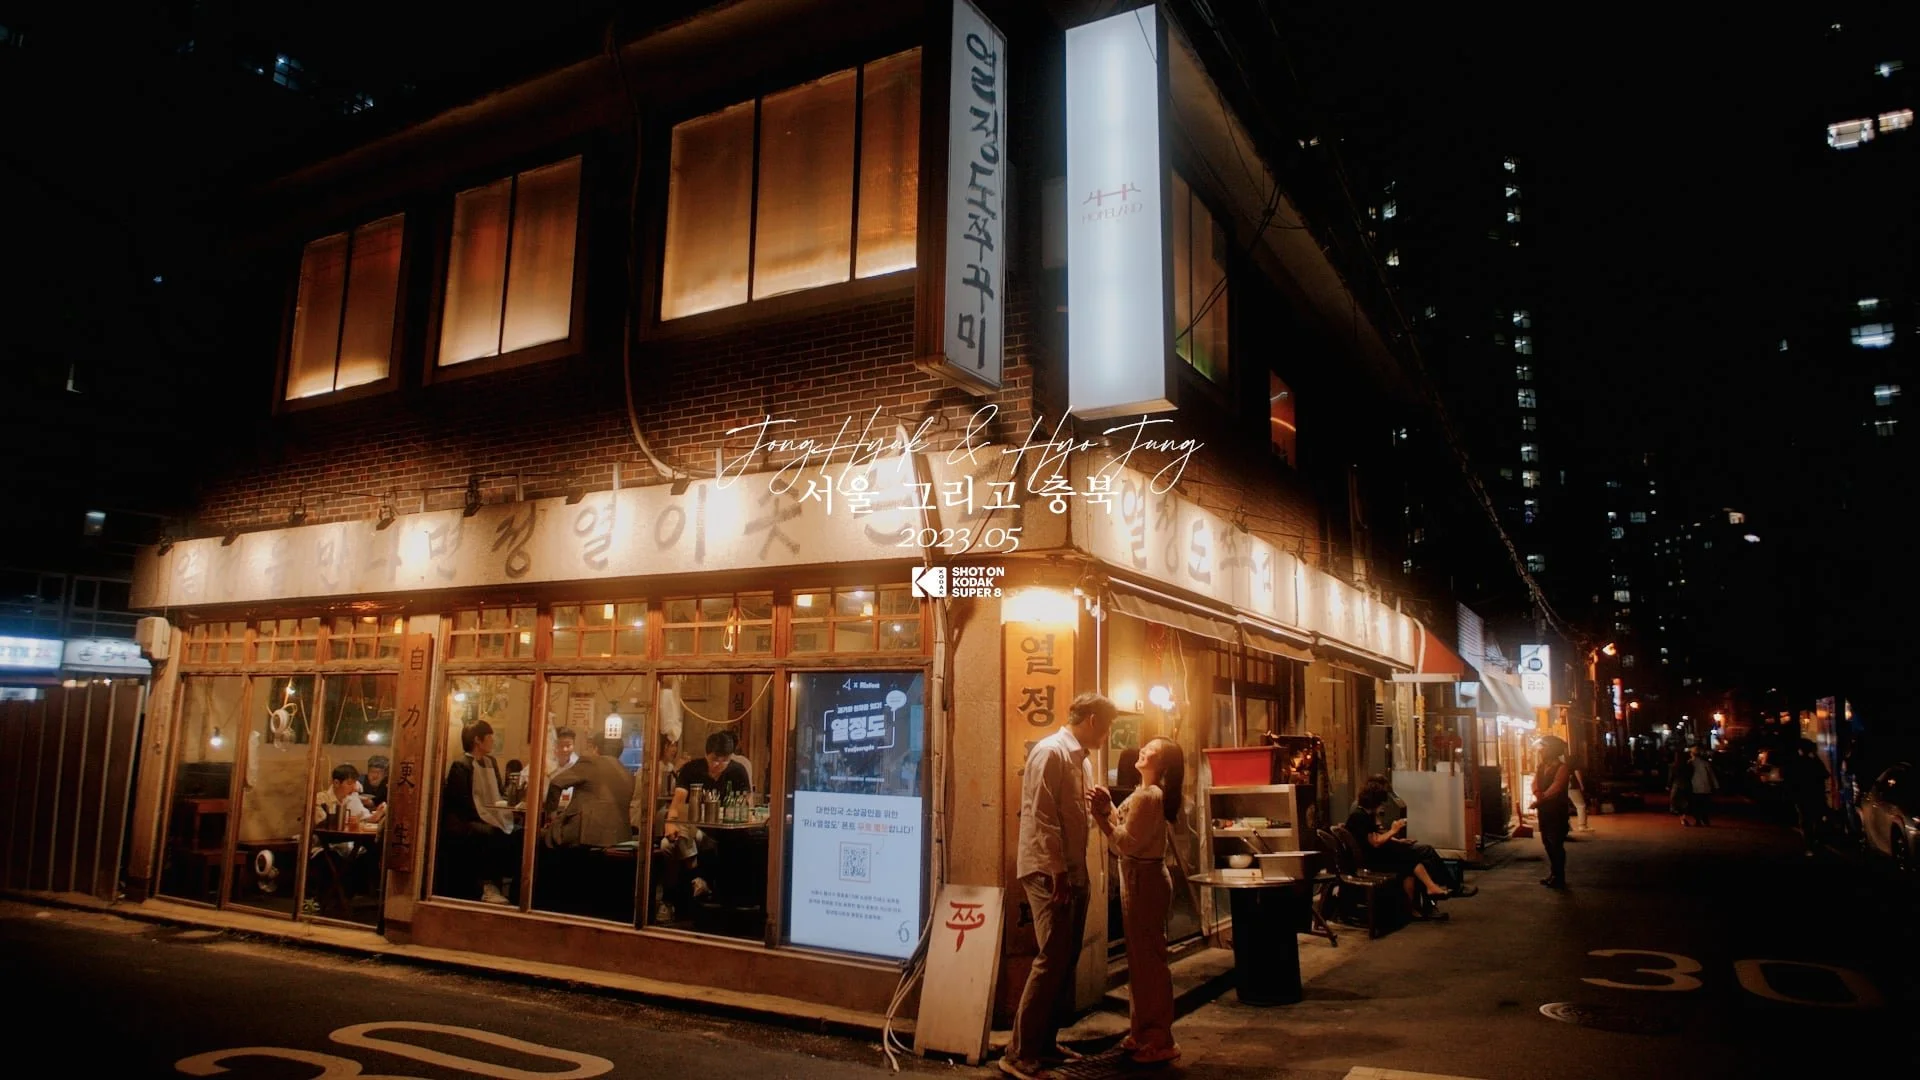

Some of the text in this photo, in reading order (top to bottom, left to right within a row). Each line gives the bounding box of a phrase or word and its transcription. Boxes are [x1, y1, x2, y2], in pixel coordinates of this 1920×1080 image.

[1017, 632, 1061, 777] 열정
[830, 714, 887, 742] 열정도
[815, 805, 844, 816] 대한민국
[883, 809, 899, 819] 위한
